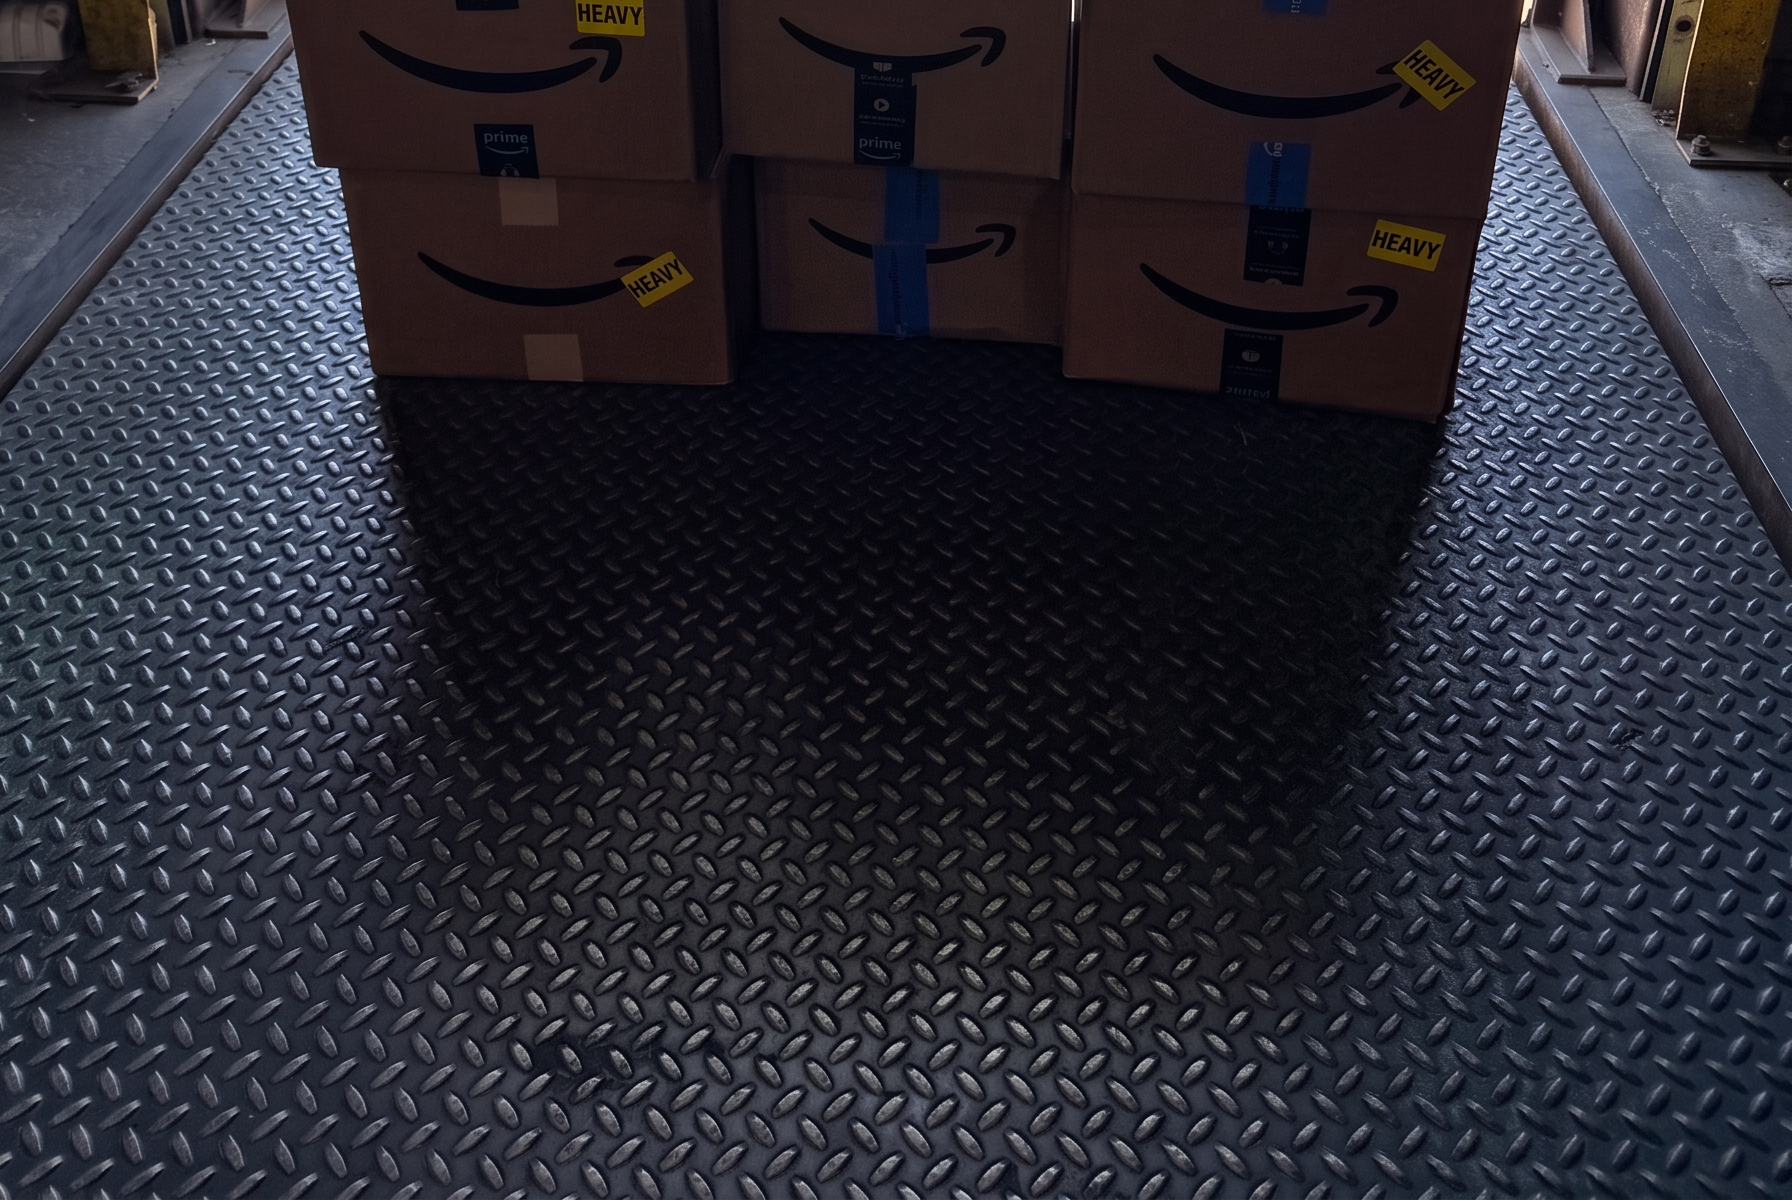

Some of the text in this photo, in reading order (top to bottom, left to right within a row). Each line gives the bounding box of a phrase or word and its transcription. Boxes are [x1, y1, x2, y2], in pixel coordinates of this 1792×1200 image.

[577, 3, 643, 25] HEAVY
[1403, 49, 1465, 99] HEAVY
[483, 130, 528, 144] prime
[858, 136, 902, 150] prime
[1371, 230, 1441, 259] HEAVY
[628, 259, 683, 298] HEAVY
